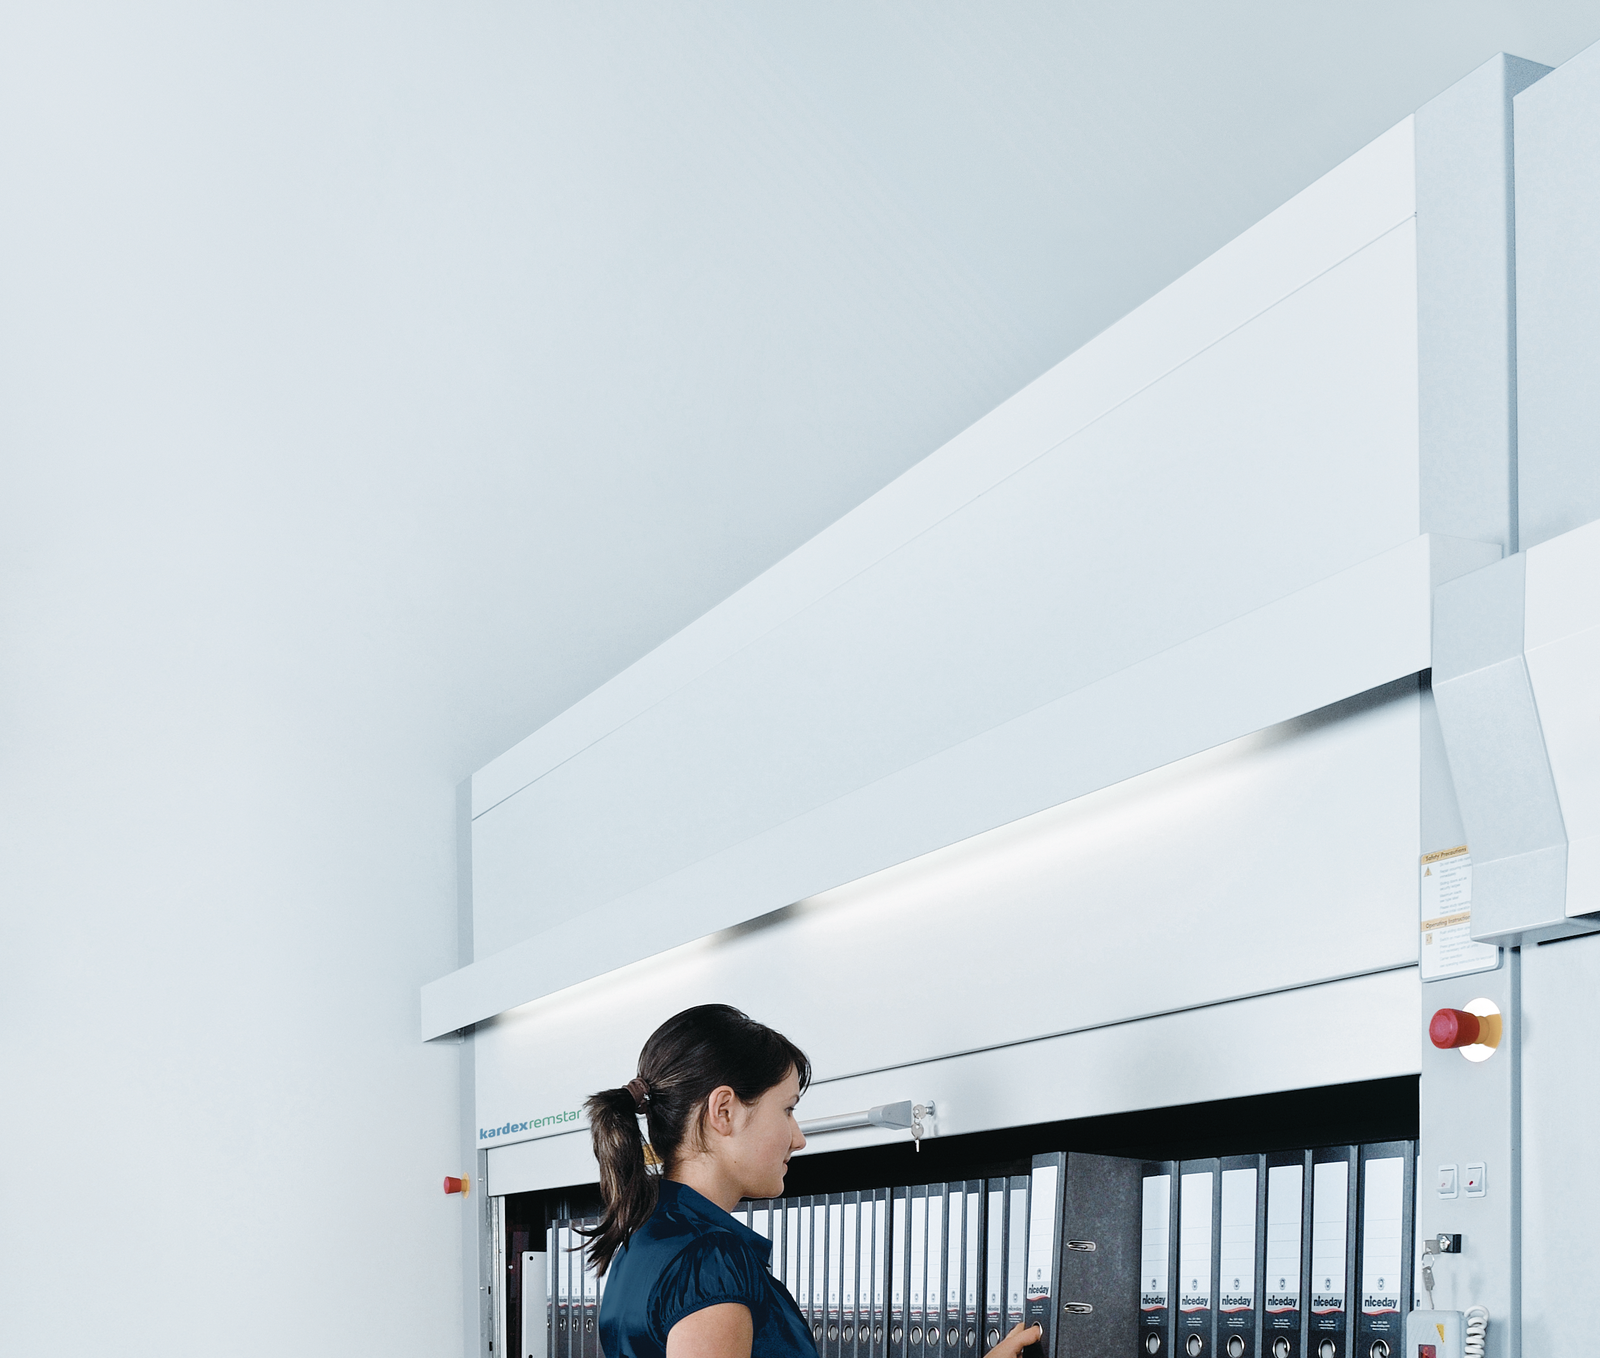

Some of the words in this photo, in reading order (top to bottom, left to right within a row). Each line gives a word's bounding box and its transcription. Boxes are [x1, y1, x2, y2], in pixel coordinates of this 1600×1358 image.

[1425, 853, 1440, 862] Safety
[1440, 847, 1467, 858] Precautions
[1425, 919, 1448, 929] Operating
[1028, 1284, 1050, 1295] niceday
[1142, 1294, 1166, 1306] niceday
[1181, 1295, 1209, 1307] niceday
[1221, 1294, 1252, 1307] niceday
[1267, 1294, 1298, 1308] niceday
[1313, 1295, 1343, 1309] niceday
[1364, 1295, 1398, 1309] niceday
